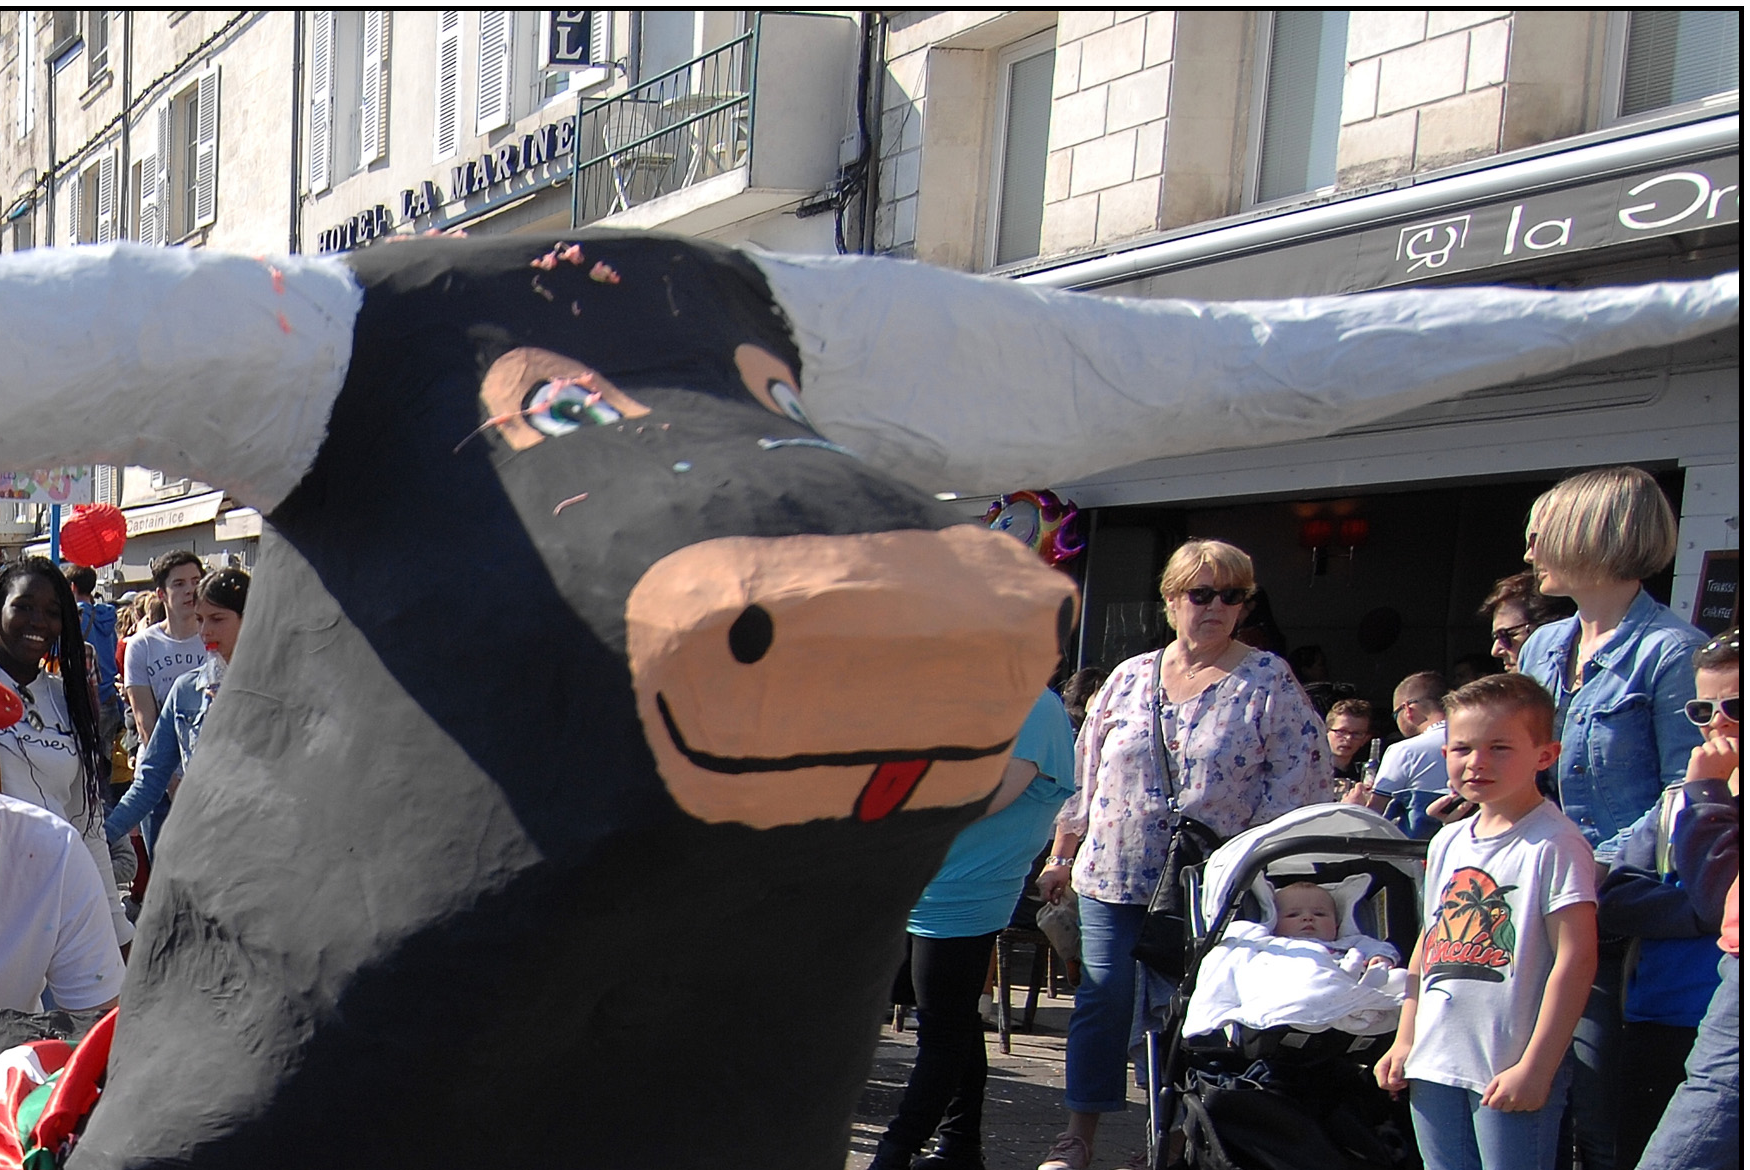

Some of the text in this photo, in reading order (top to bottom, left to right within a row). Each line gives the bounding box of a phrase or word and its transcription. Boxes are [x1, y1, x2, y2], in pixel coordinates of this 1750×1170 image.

[317, 115, 575, 253] HOTEL LA MARINE
[1503, 204, 1573, 256] la
[1618, 171, 1739, 230] Gr
[127, 511, 185, 533] Captain Ice
[146, 653, 205, 677] DISCOV
